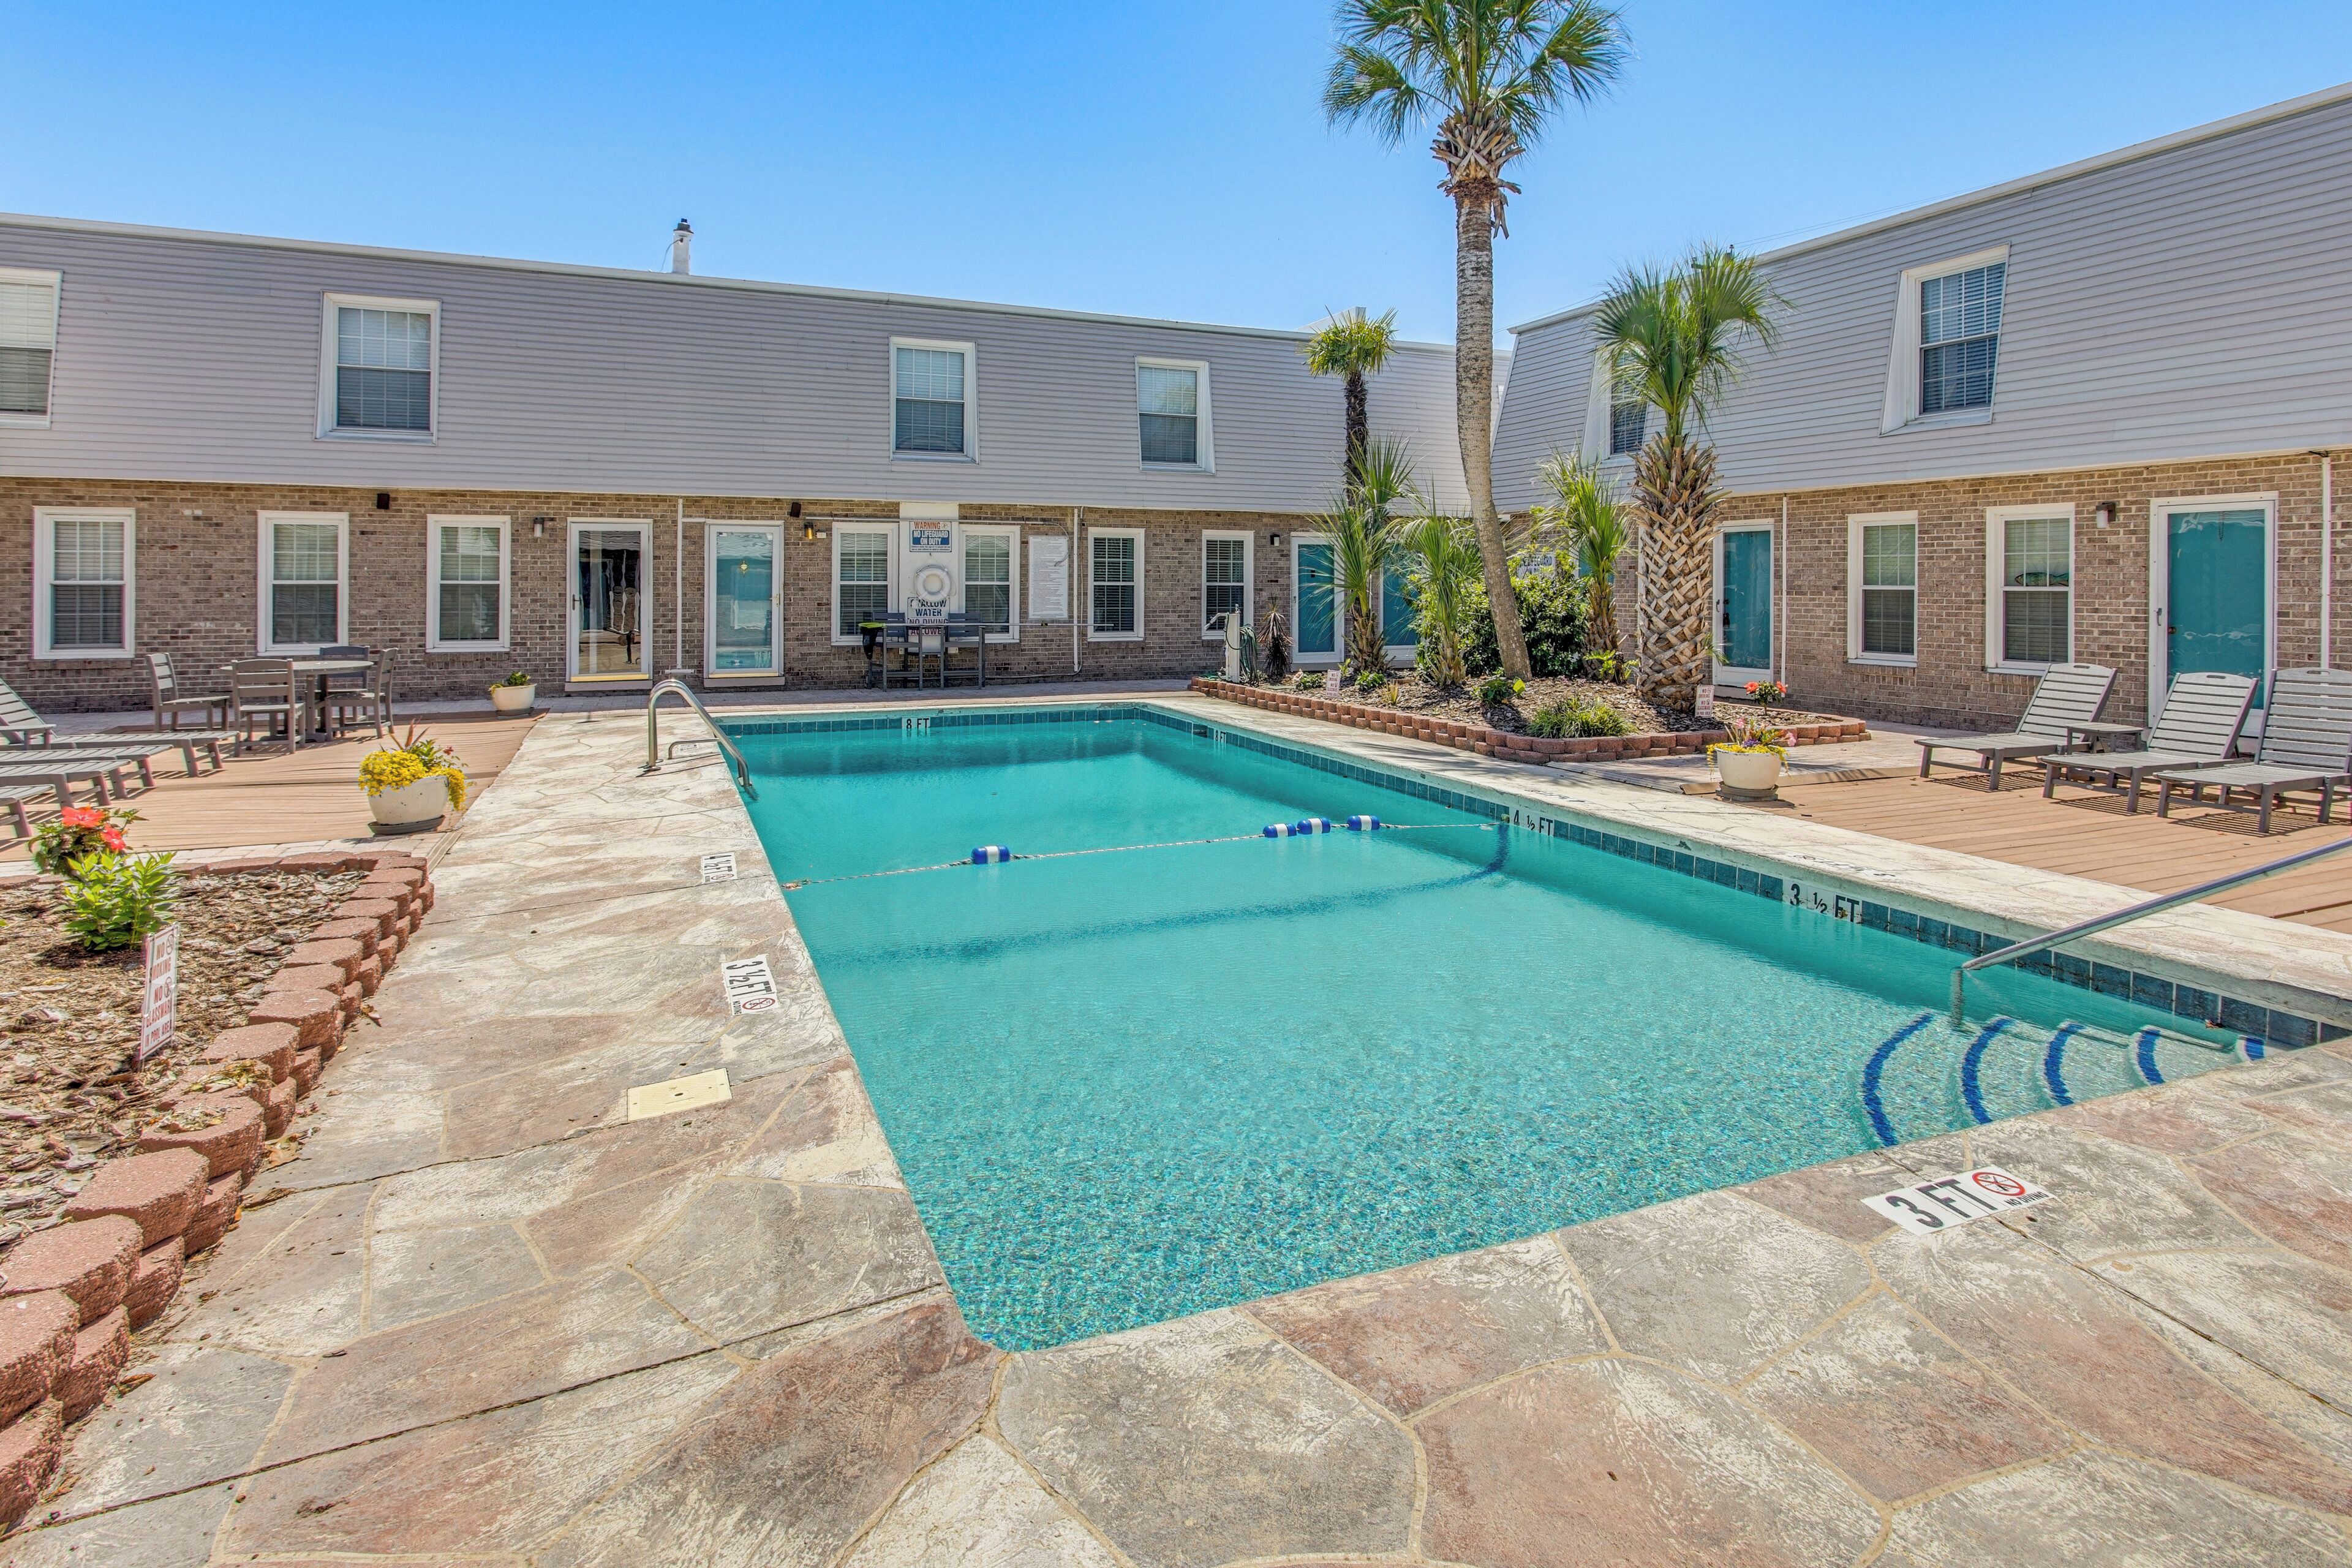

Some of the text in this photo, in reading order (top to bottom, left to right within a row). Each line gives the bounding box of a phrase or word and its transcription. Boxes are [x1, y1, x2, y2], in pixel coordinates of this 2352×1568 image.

[910, 598, 947, 608] SALLOW
[907, 718, 930, 729] 8 FT
[1215, 729, 1226, 744] 8 FT
[1513, 810, 1520, 826] 4
[1539, 816, 1553, 836] FT
[704, 865, 733, 875] FT
[1790, 883, 1800, 906] 3
[1834, 894, 1860, 923] FT
[156, 941, 165, 960] NO
[726, 960, 763, 970] 3
[154, 985, 163, 1005] NO
[730, 981, 772, 997] FT
[1885, 1178, 1999, 1227] 3 FT
[2003, 1190, 2050, 1207] NO DIVING
